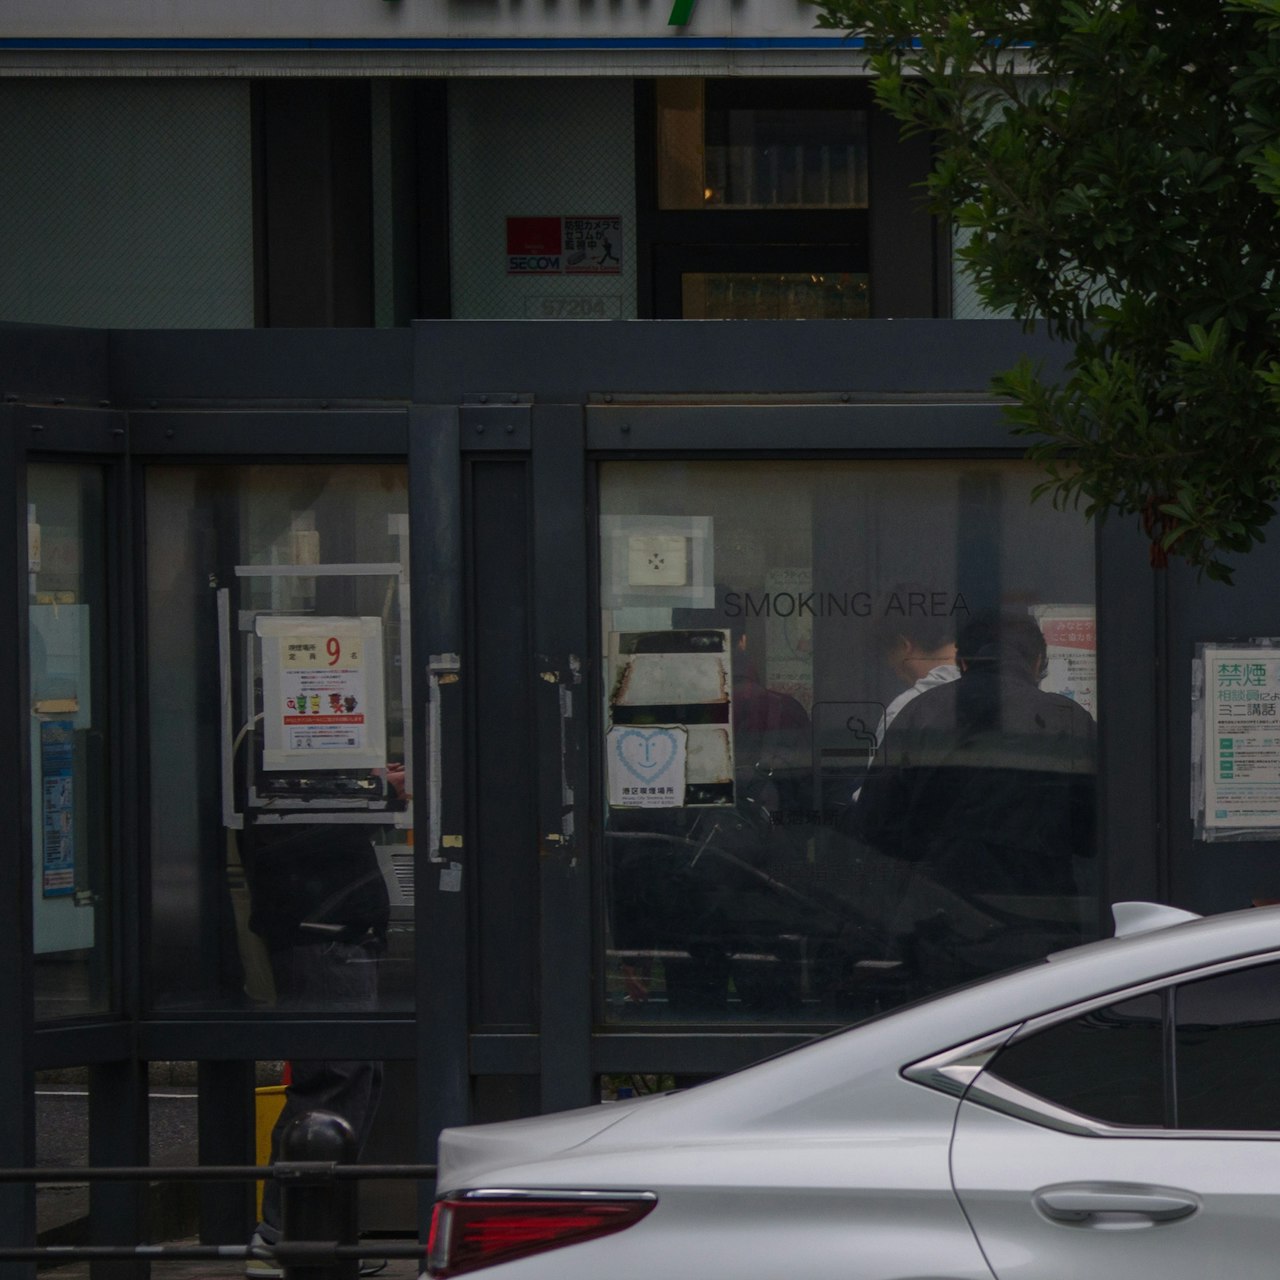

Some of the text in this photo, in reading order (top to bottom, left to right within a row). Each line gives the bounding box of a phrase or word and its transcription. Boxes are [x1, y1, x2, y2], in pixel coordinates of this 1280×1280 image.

[510, 257, 561, 269] SECOM
[724, 592, 971, 617] SMOKING AREA
[326, 637, 341, 667] 9
[1217, 663, 1267, 687] 禁煙
[1218, 703, 1277, 717] ミニ講話
[622, 786, 675, 796] 港区喫煙場所
